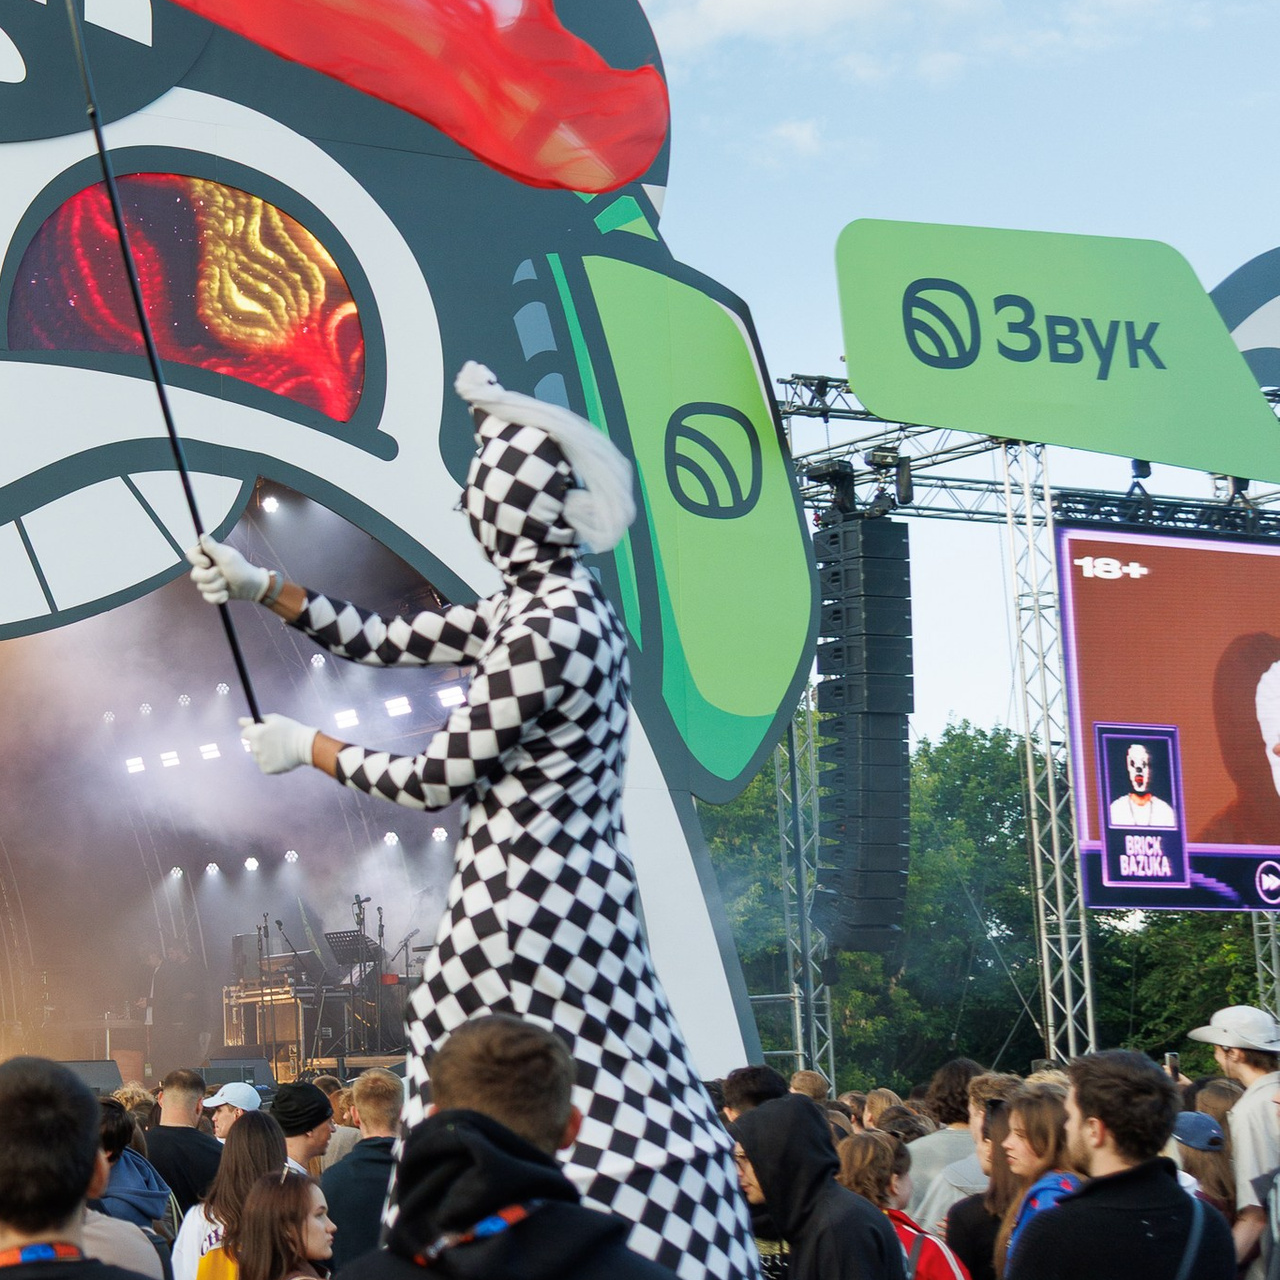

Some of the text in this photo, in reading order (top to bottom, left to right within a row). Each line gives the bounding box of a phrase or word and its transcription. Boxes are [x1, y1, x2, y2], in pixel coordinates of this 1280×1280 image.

[993, 294, 1167, 381] Звук
[1073, 556, 1149, 580] 18+
[1124, 834, 1164, 856] BRICK
[1119, 854, 1172, 877] BAZUKA
